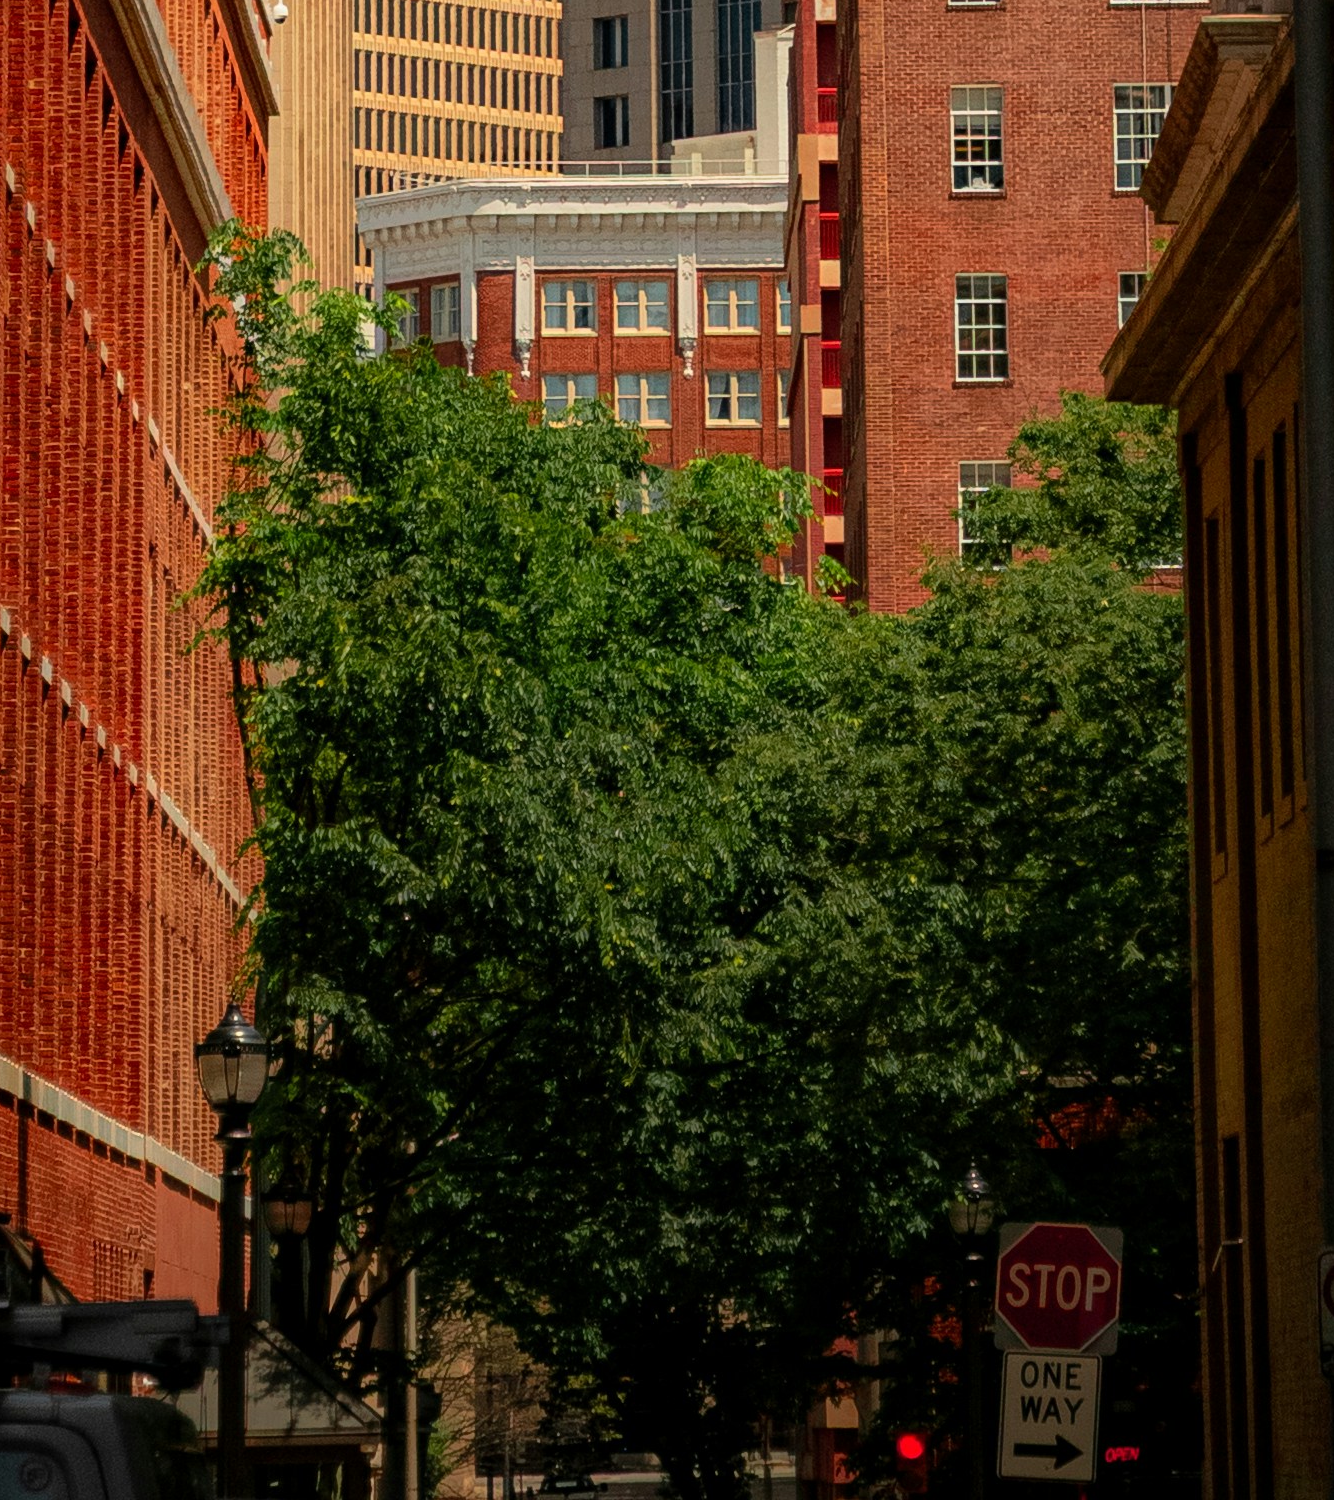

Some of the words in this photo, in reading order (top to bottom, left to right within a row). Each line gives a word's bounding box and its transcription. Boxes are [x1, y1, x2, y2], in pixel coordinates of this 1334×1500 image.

[1005, 1262, 1112, 1312] STOP
[1020, 1361, 1082, 1391] ONE
[1020, 1396, 1084, 1425] WAY
[1105, 1445, 1141, 1463] OPEN
